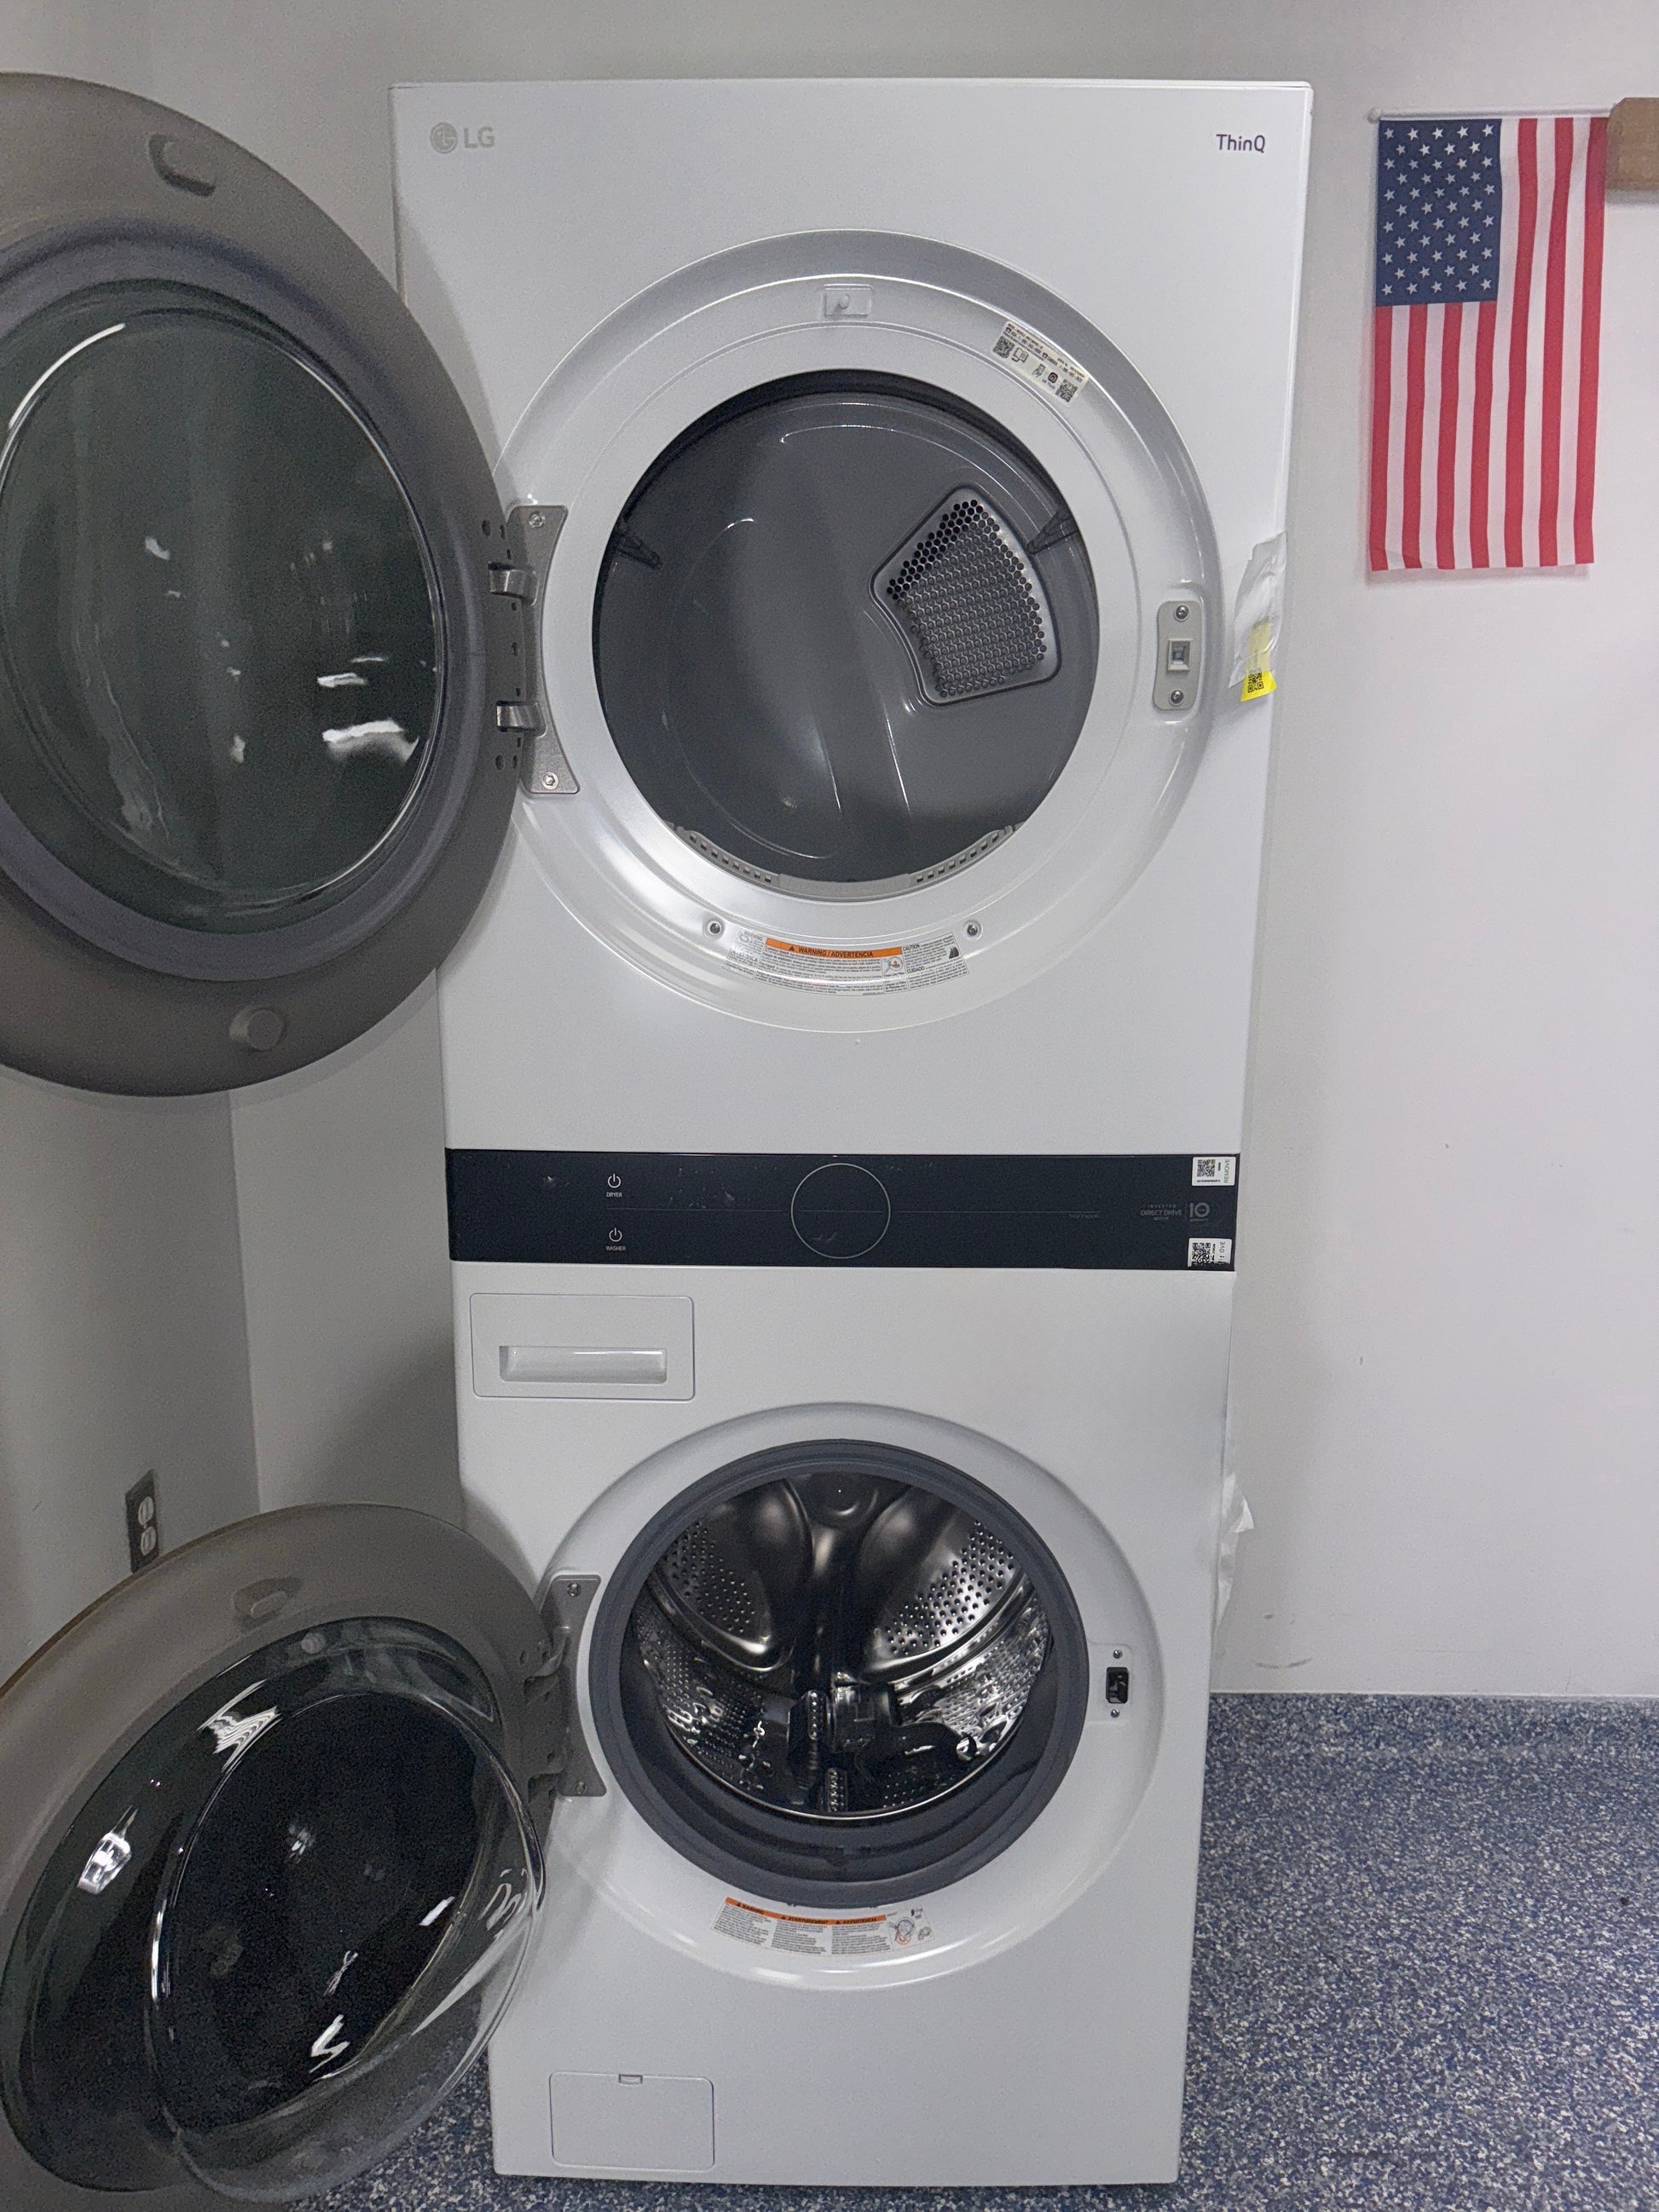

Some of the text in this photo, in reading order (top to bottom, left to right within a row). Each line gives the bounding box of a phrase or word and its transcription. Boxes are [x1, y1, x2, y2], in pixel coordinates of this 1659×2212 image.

[463, 126, 494, 148] LG
[1216, 134, 1265, 153] ThinQ
[798, 946, 827, 956] WARNING
[830, 950, 874, 959] ADVERTENCIA
[906, 965, 925, 973] CUIDADO
